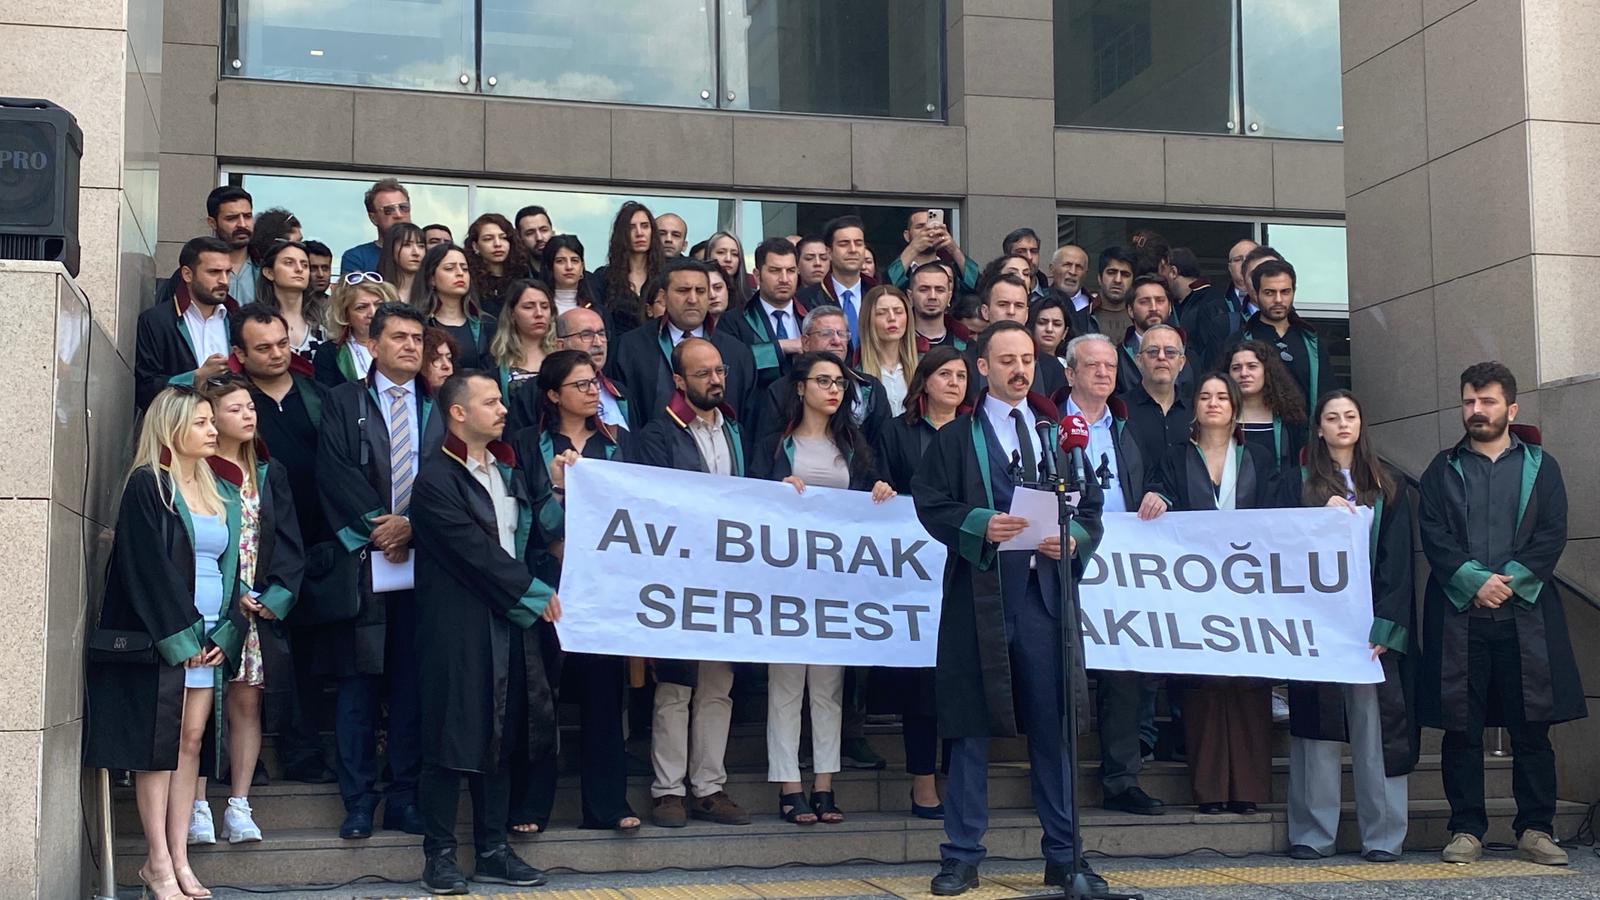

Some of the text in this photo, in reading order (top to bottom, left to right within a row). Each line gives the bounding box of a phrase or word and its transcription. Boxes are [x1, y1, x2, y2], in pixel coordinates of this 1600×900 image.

[596, 508, 690, 559] Av.
[716, 519, 932, 581] BURAK
[636, 583, 931, 642] SERBEST
